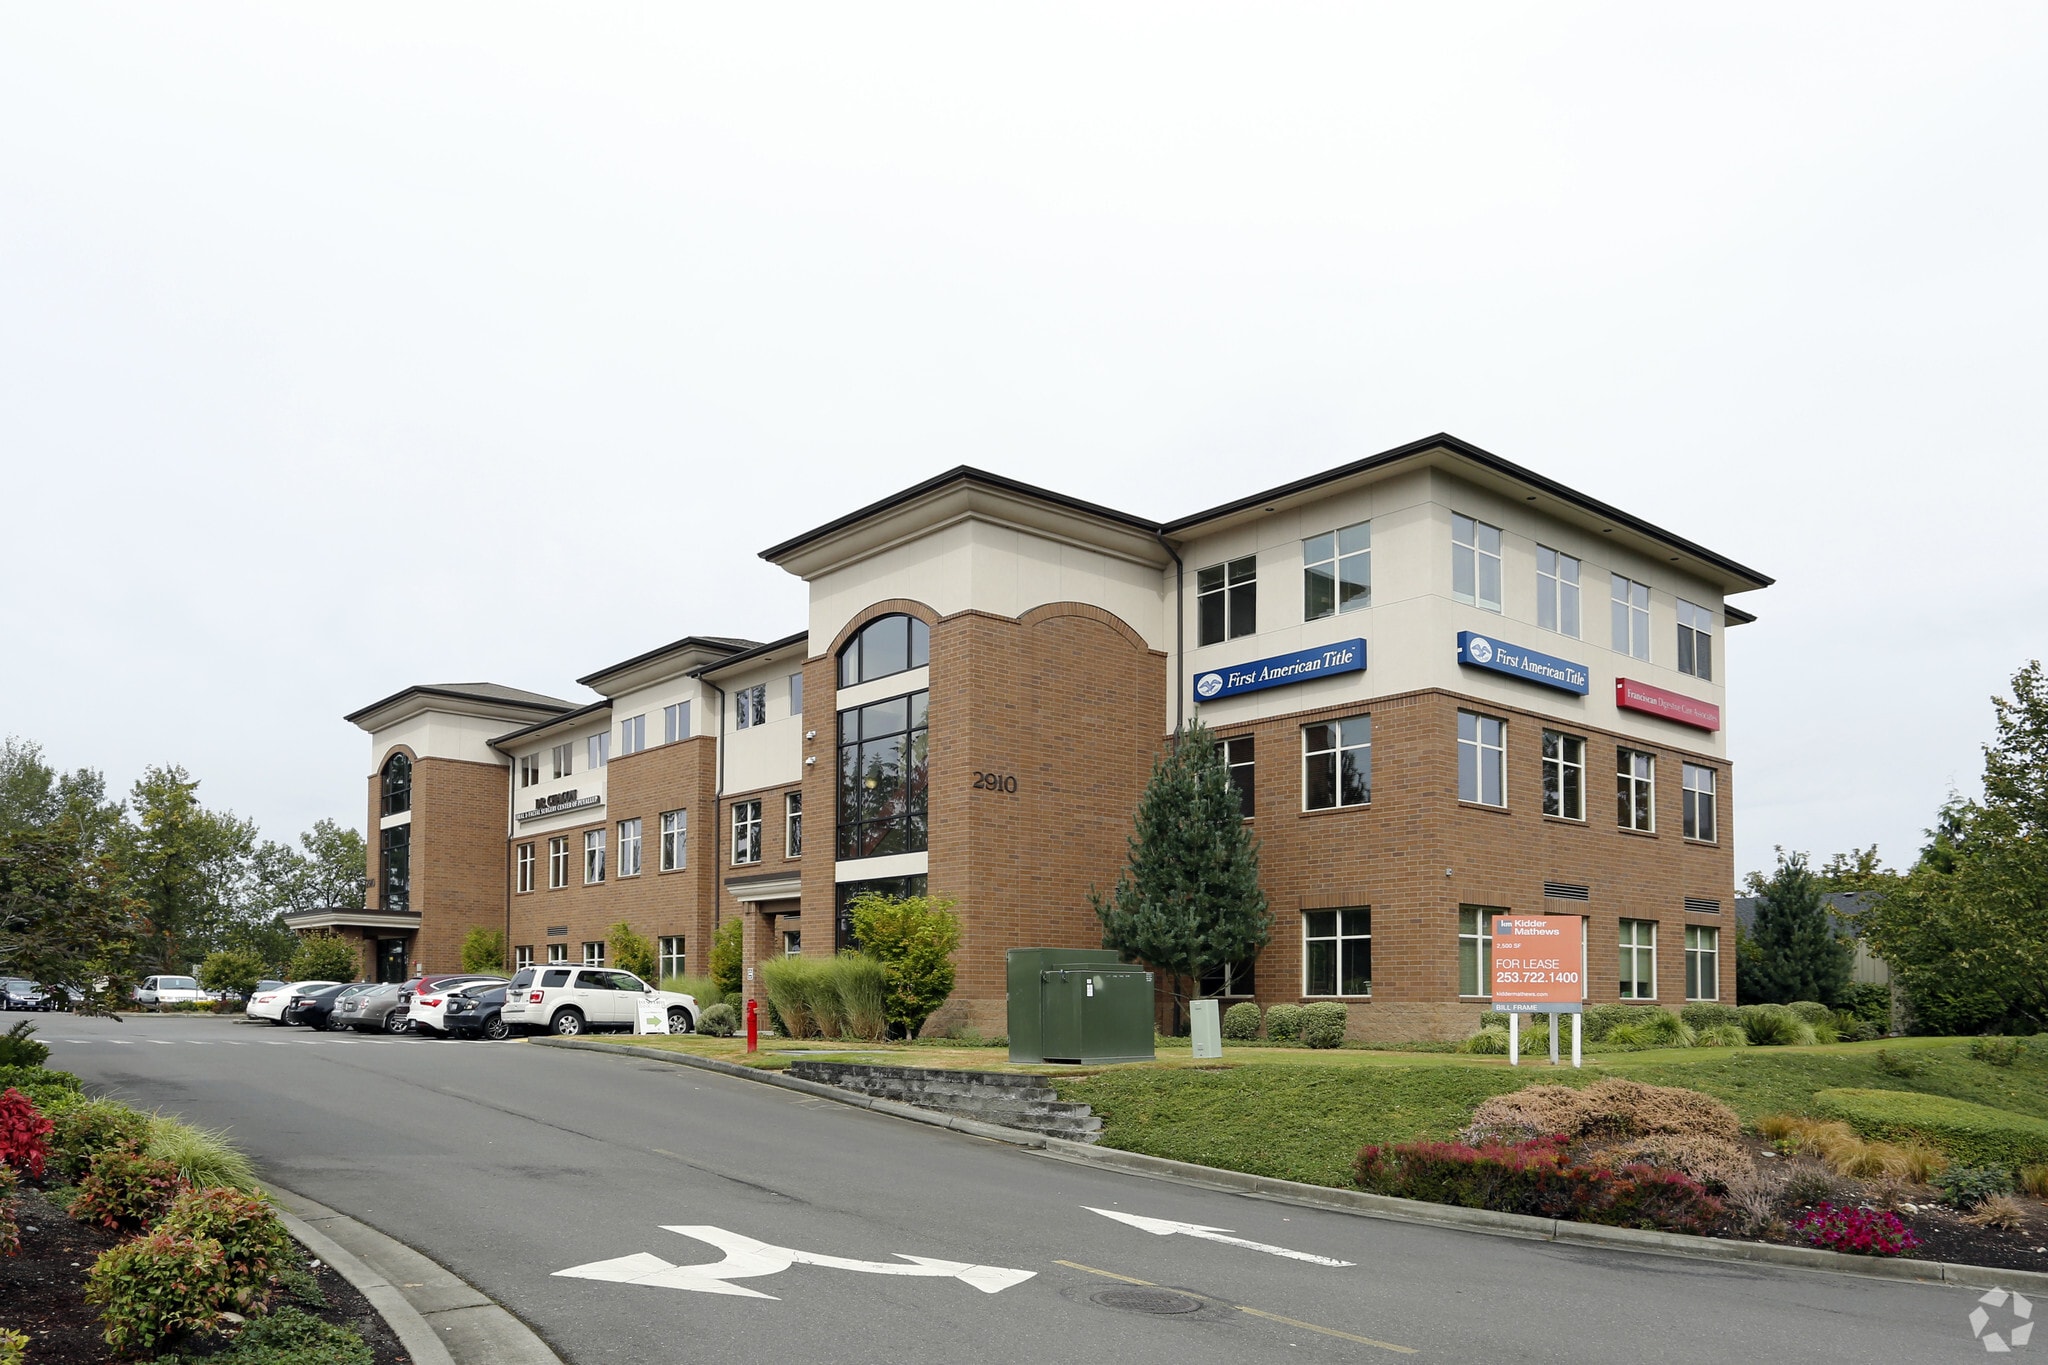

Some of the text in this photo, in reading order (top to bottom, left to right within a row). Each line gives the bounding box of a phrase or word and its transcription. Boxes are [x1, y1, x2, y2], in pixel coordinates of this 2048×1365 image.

[1227, 650, 1353, 688] First American Title
[1497, 648, 1584, 686] First American Title
[1627, 688, 1657, 705] Franciscan
[973, 771, 1018, 793] 2910
[557, 802, 571, 811] CENTER
[1515, 928, 1560, 936] Mathews
[1496, 959, 1559, 969] FOR LEASE
[1496, 972, 1578, 983] 253.722.1400
